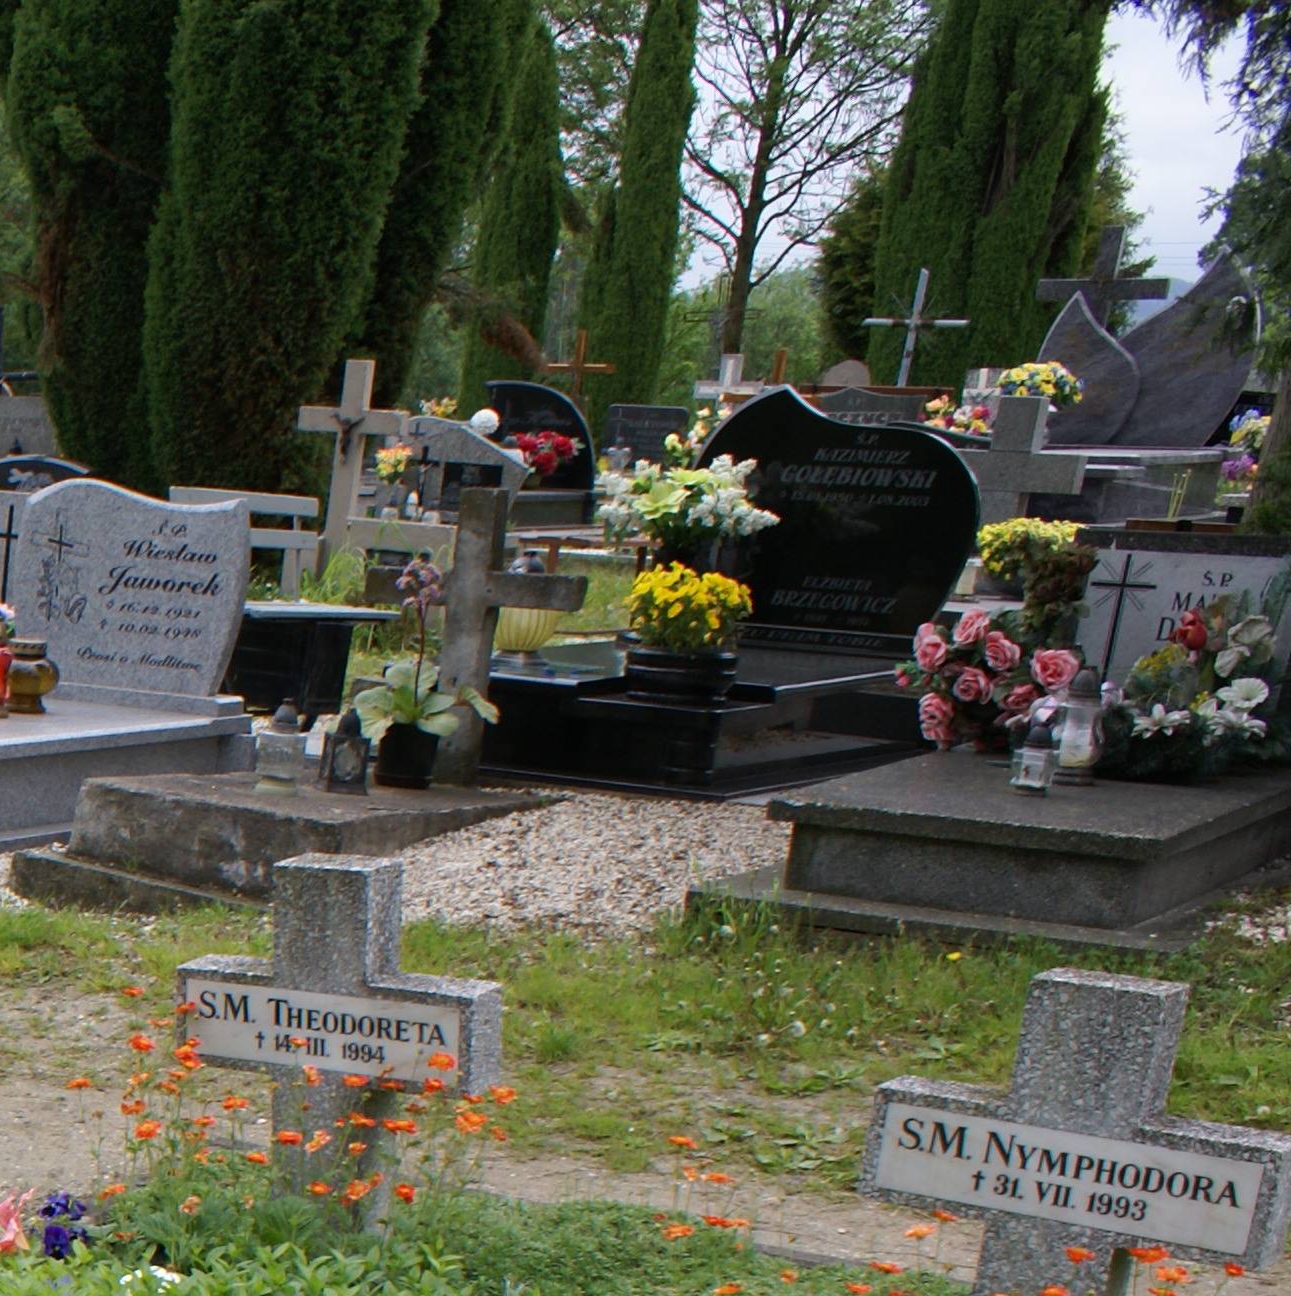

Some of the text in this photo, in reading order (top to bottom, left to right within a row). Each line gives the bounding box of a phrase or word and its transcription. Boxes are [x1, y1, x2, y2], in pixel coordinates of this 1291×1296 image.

[813, 448, 911, 465] KAZIMIERZ
[780, 465, 937, 489] GOŁĘBIOWSKI
[123, 539, 217, 565] Wiesław
[99, 565, 221, 596] Jaworek
[199, 989, 446, 1046] S.M. THEODORETA
[341, 1042, 386, 1064] 1994
[898, 1117, 1241, 1209] S.M. NYMPHODORA
[993, 1172, 1148, 1222] 31. VII. 1993
